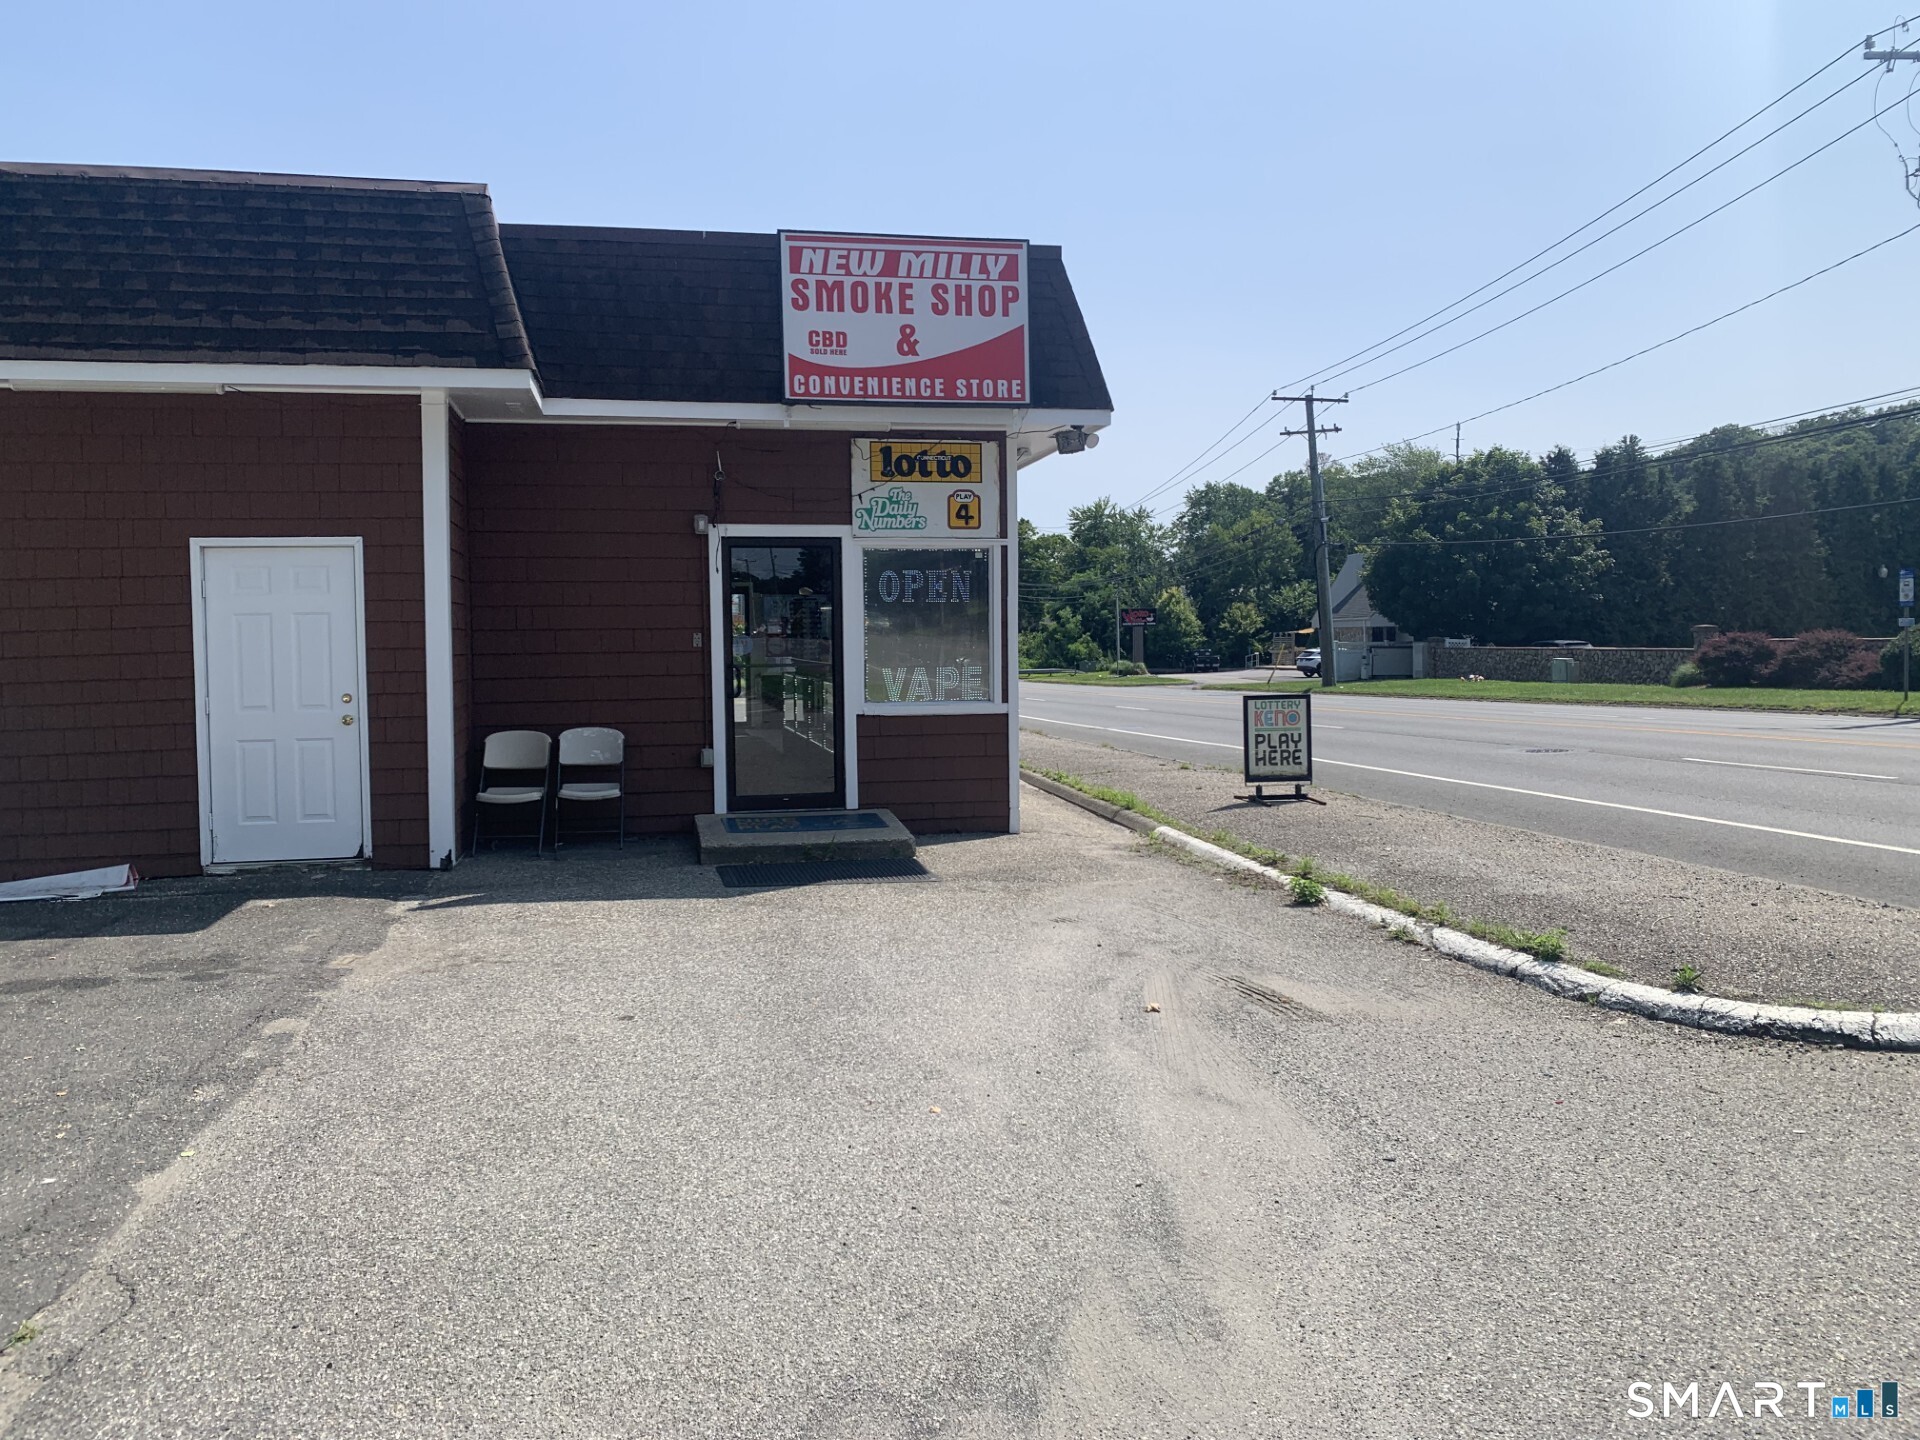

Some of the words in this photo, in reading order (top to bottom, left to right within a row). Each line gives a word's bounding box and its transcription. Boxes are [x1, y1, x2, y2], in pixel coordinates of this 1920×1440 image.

[800, 248, 886, 276] NEW
[898, 252, 1008, 280] MILLY
[790, 278, 915, 315] SMOKE
[930, 283, 1020, 317] SHOP
[808, 329, 848, 348] CBD
[896, 323, 920, 357] &
[829, 348, 848, 356] HERE
[793, 374, 945, 397] CONVENIENCE
[955, 379, 1022, 398] STORE
[888, 486, 912, 502] The
[869, 497, 918, 518] Daily
[955, 504, 974, 525] 4
[855, 508, 927, 531] Numbers
[878, 569, 972, 603] OPEN
[882, 666, 984, 702] VAPE
[1254, 700, 1301, 710] LOTTERY
[1254, 732, 1302, 749] PLAY
[1255, 749, 1303, 766] HERE
